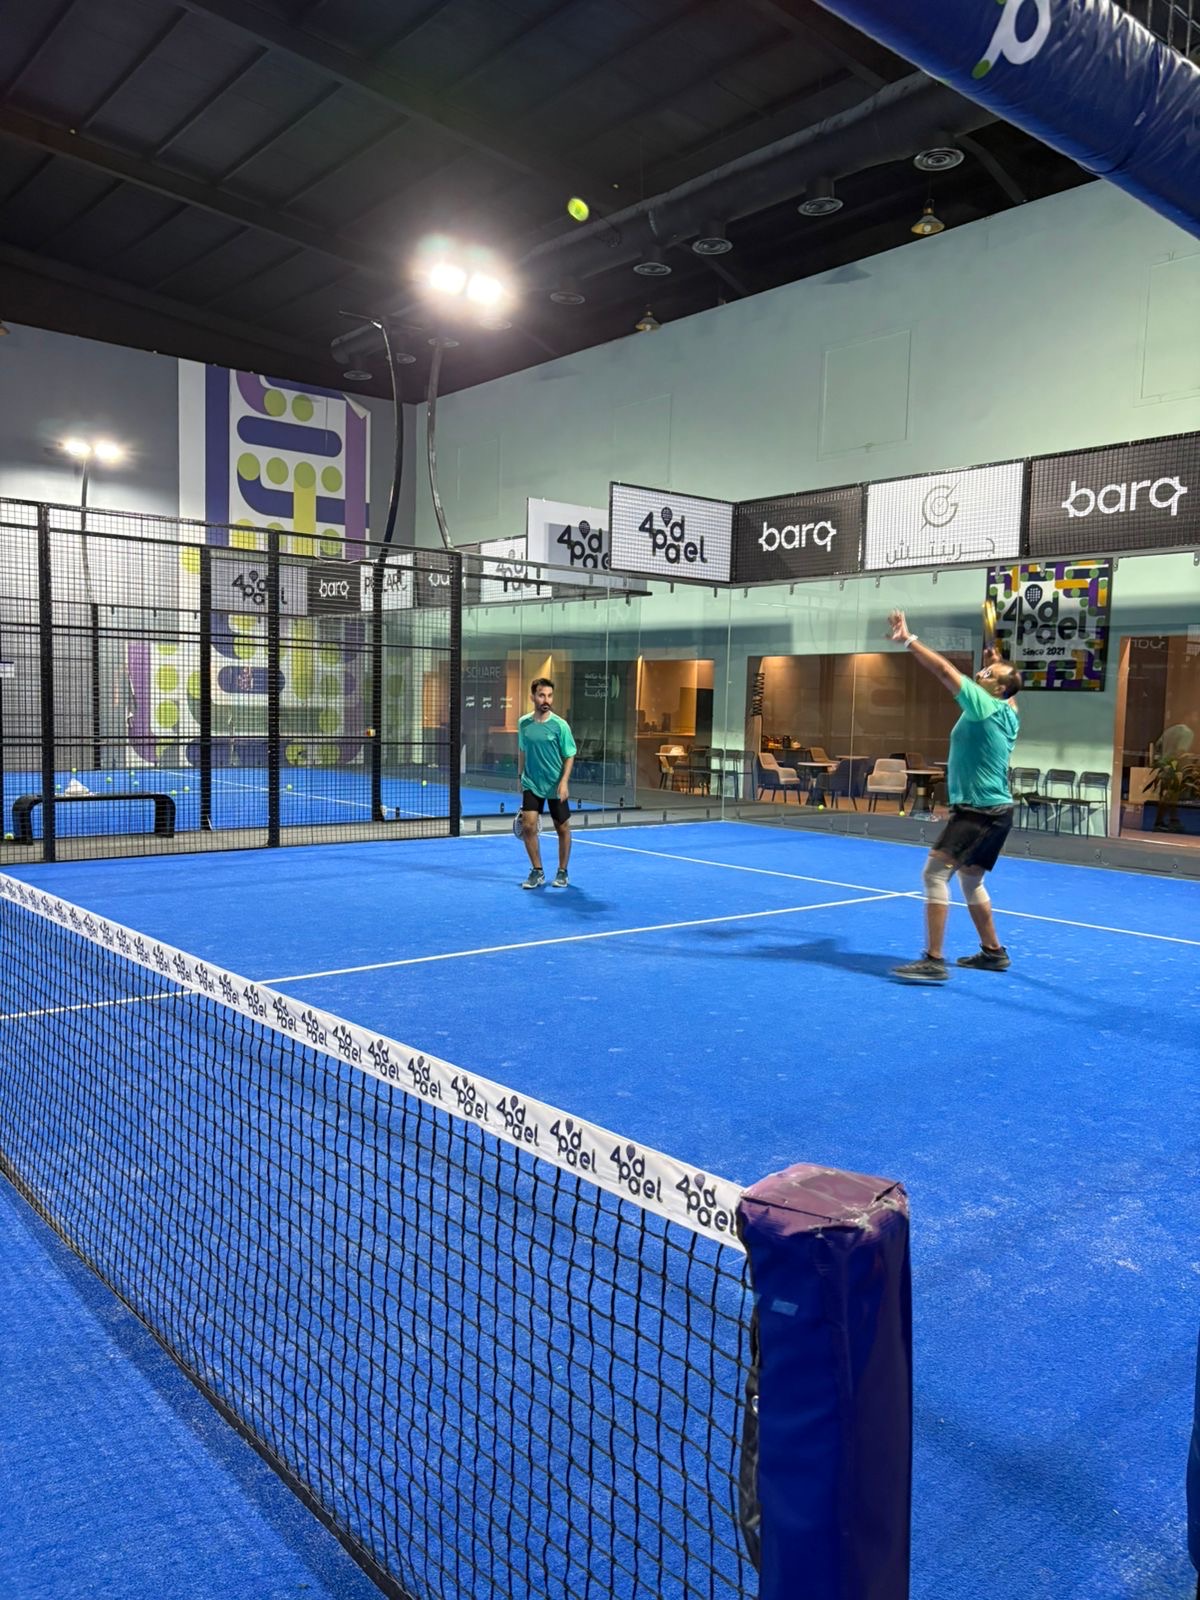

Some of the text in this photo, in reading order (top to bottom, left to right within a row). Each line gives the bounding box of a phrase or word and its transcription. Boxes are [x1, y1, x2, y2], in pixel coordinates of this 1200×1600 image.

[1061, 476, 1187, 517] barq
[758, 520, 837, 552] barq
[318, 578, 350, 600] barq
[1046, 647, 1066, 656] 2021
